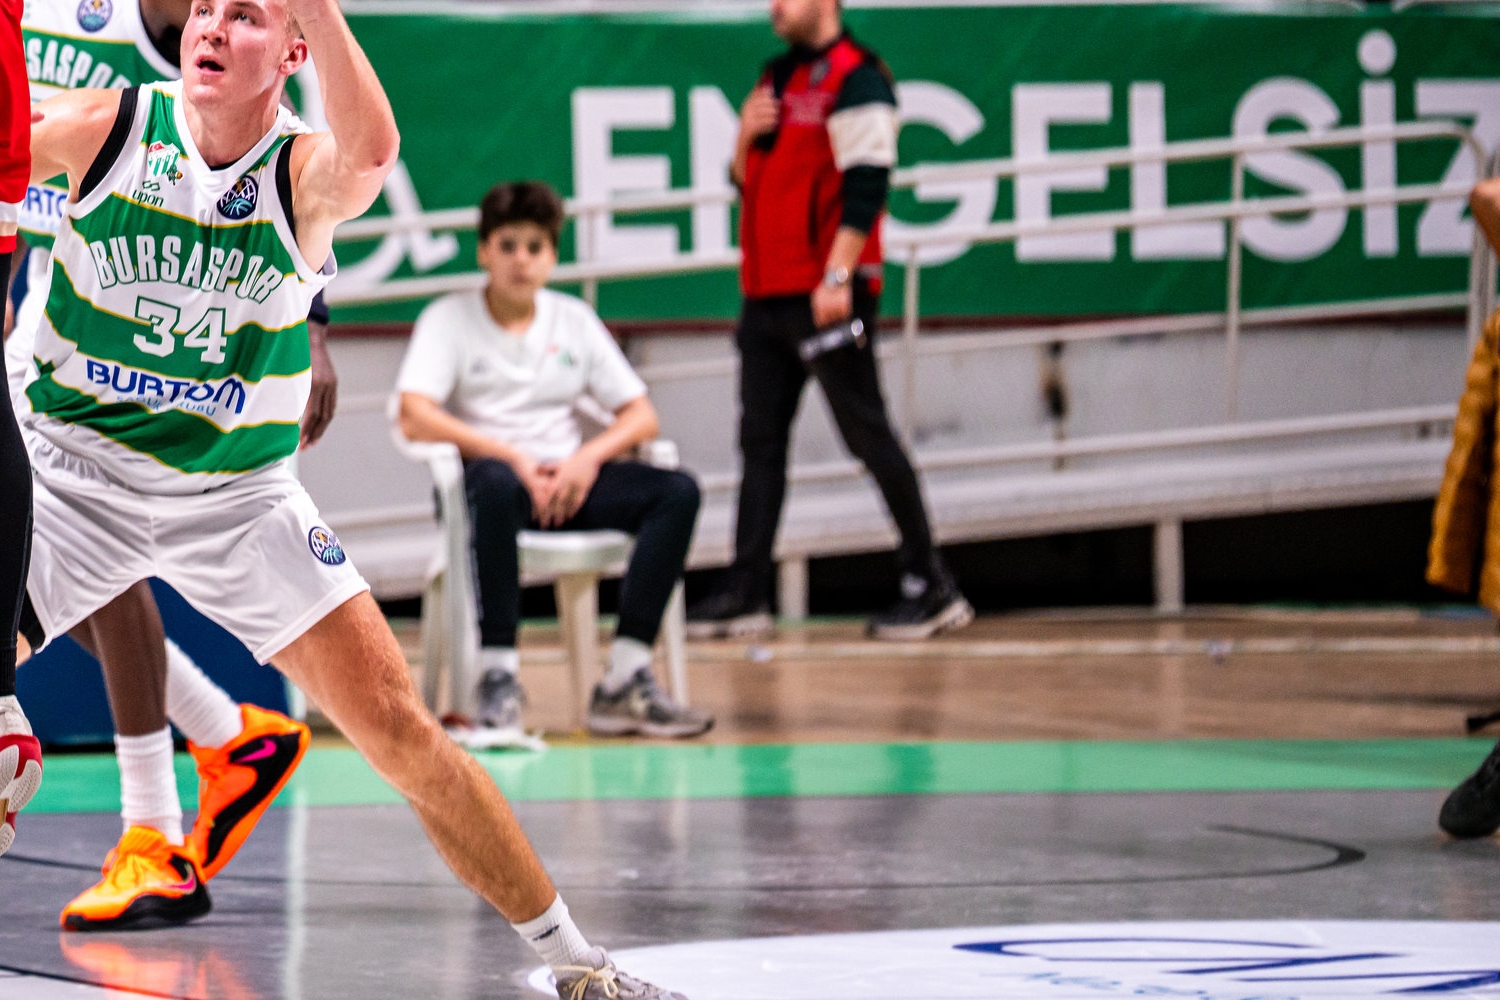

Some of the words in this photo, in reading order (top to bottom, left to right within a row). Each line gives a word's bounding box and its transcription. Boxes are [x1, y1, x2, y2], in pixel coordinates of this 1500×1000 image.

[132, 188, 164, 208] upon
[88, 234, 284, 305] BURSASPOR
[133, 295, 228, 365] 34
[86, 358, 247, 415] BURTOM
